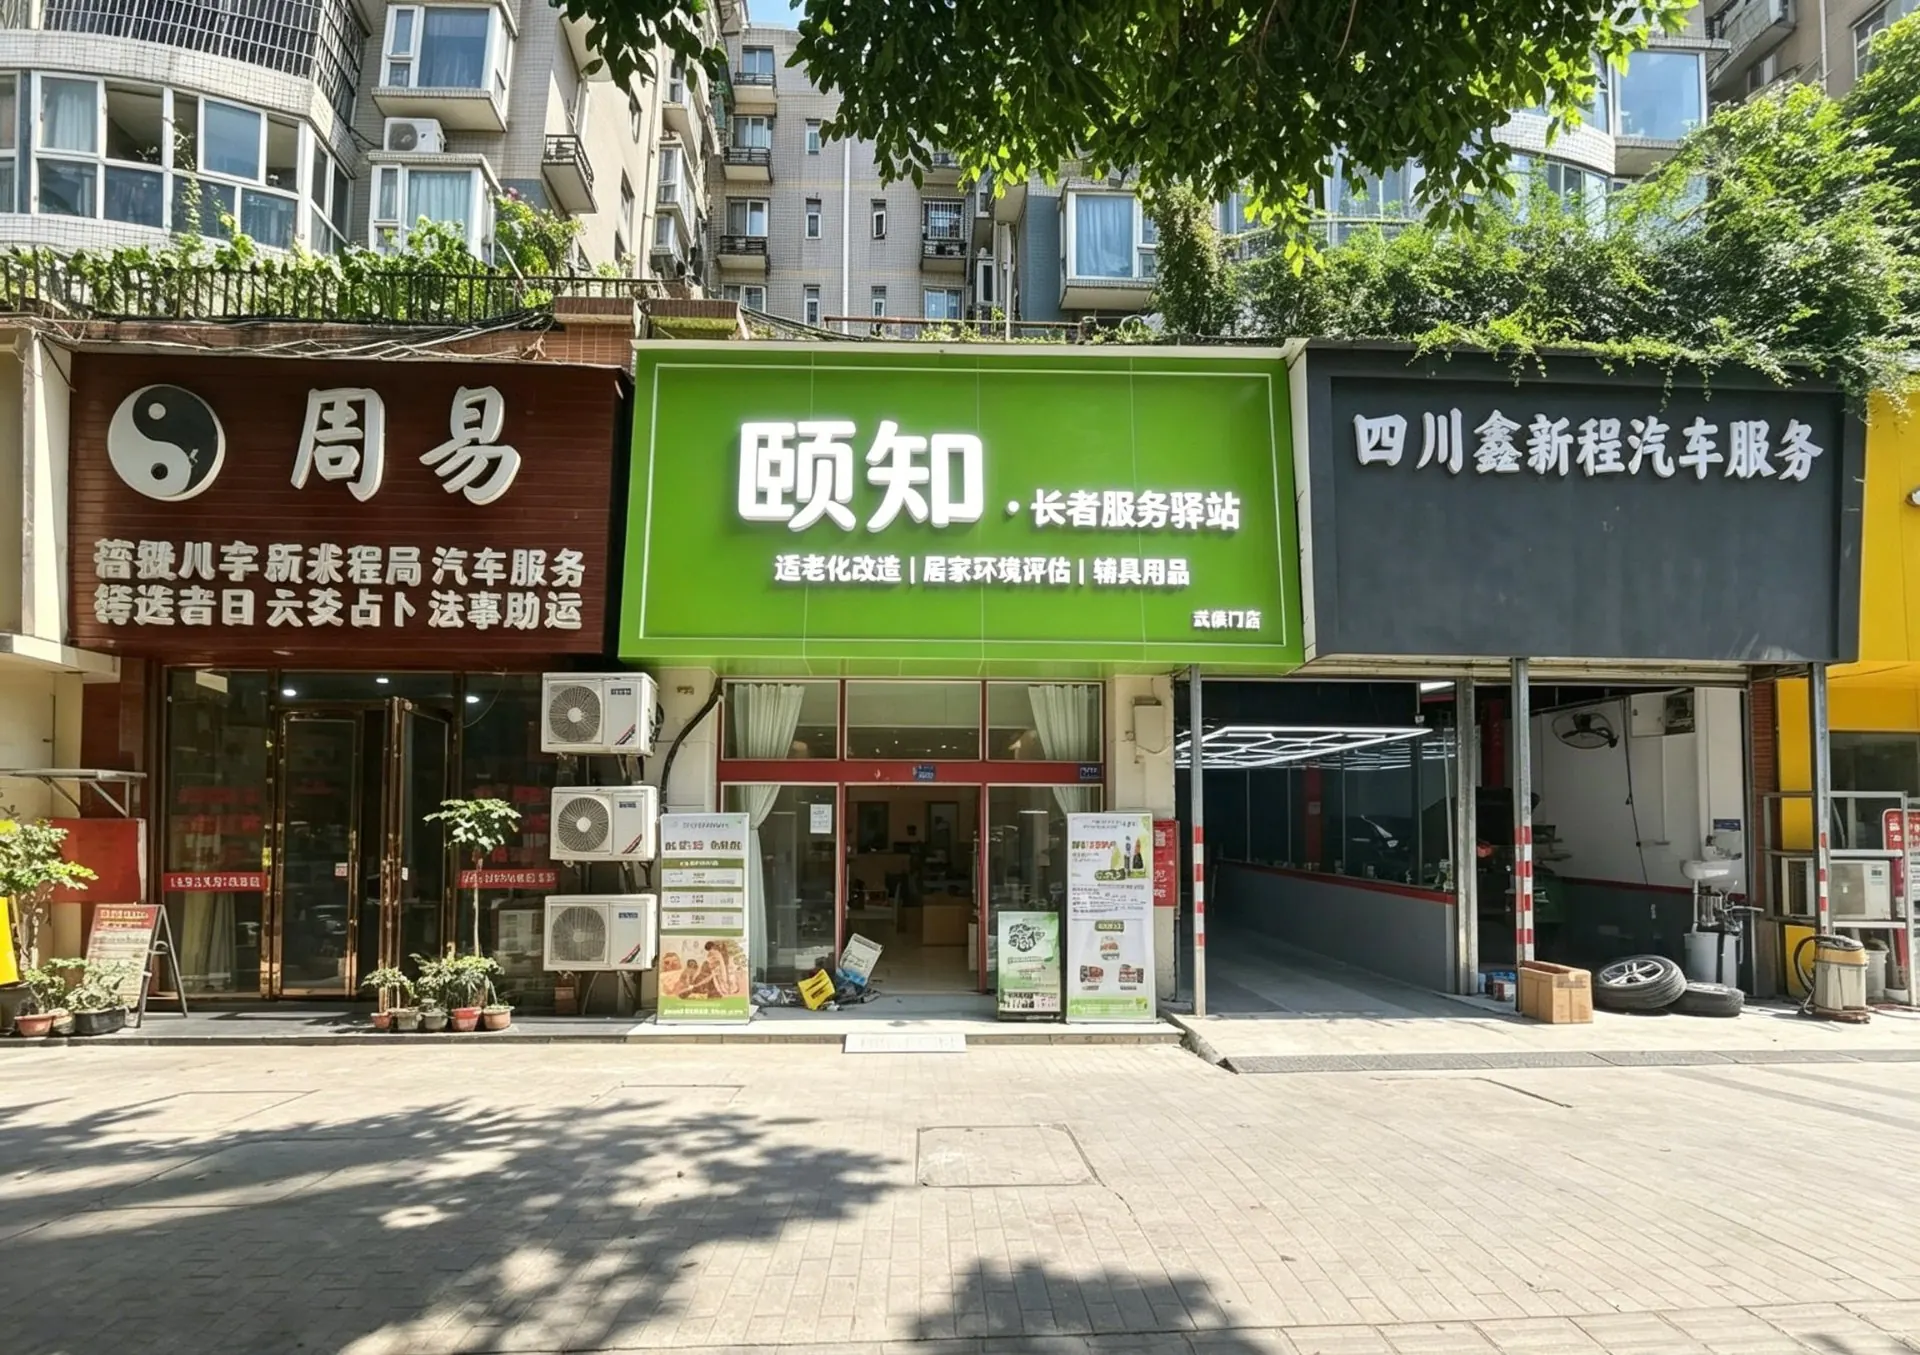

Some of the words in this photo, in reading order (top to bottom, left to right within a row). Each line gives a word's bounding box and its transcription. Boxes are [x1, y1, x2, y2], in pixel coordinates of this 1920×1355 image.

[290, 385, 522, 505] 周易
[737, 419, 983, 533] 颐知
[1353, 407, 1824, 481] 四川鑫新程汽车服务
[431, 546, 586, 588] 汽车服务
[774, 553, 902, 583] 适老化改造
[923, 555, 1071, 585] 居家环境评估
[1093, 556, 1190, 586] 辅具用品
